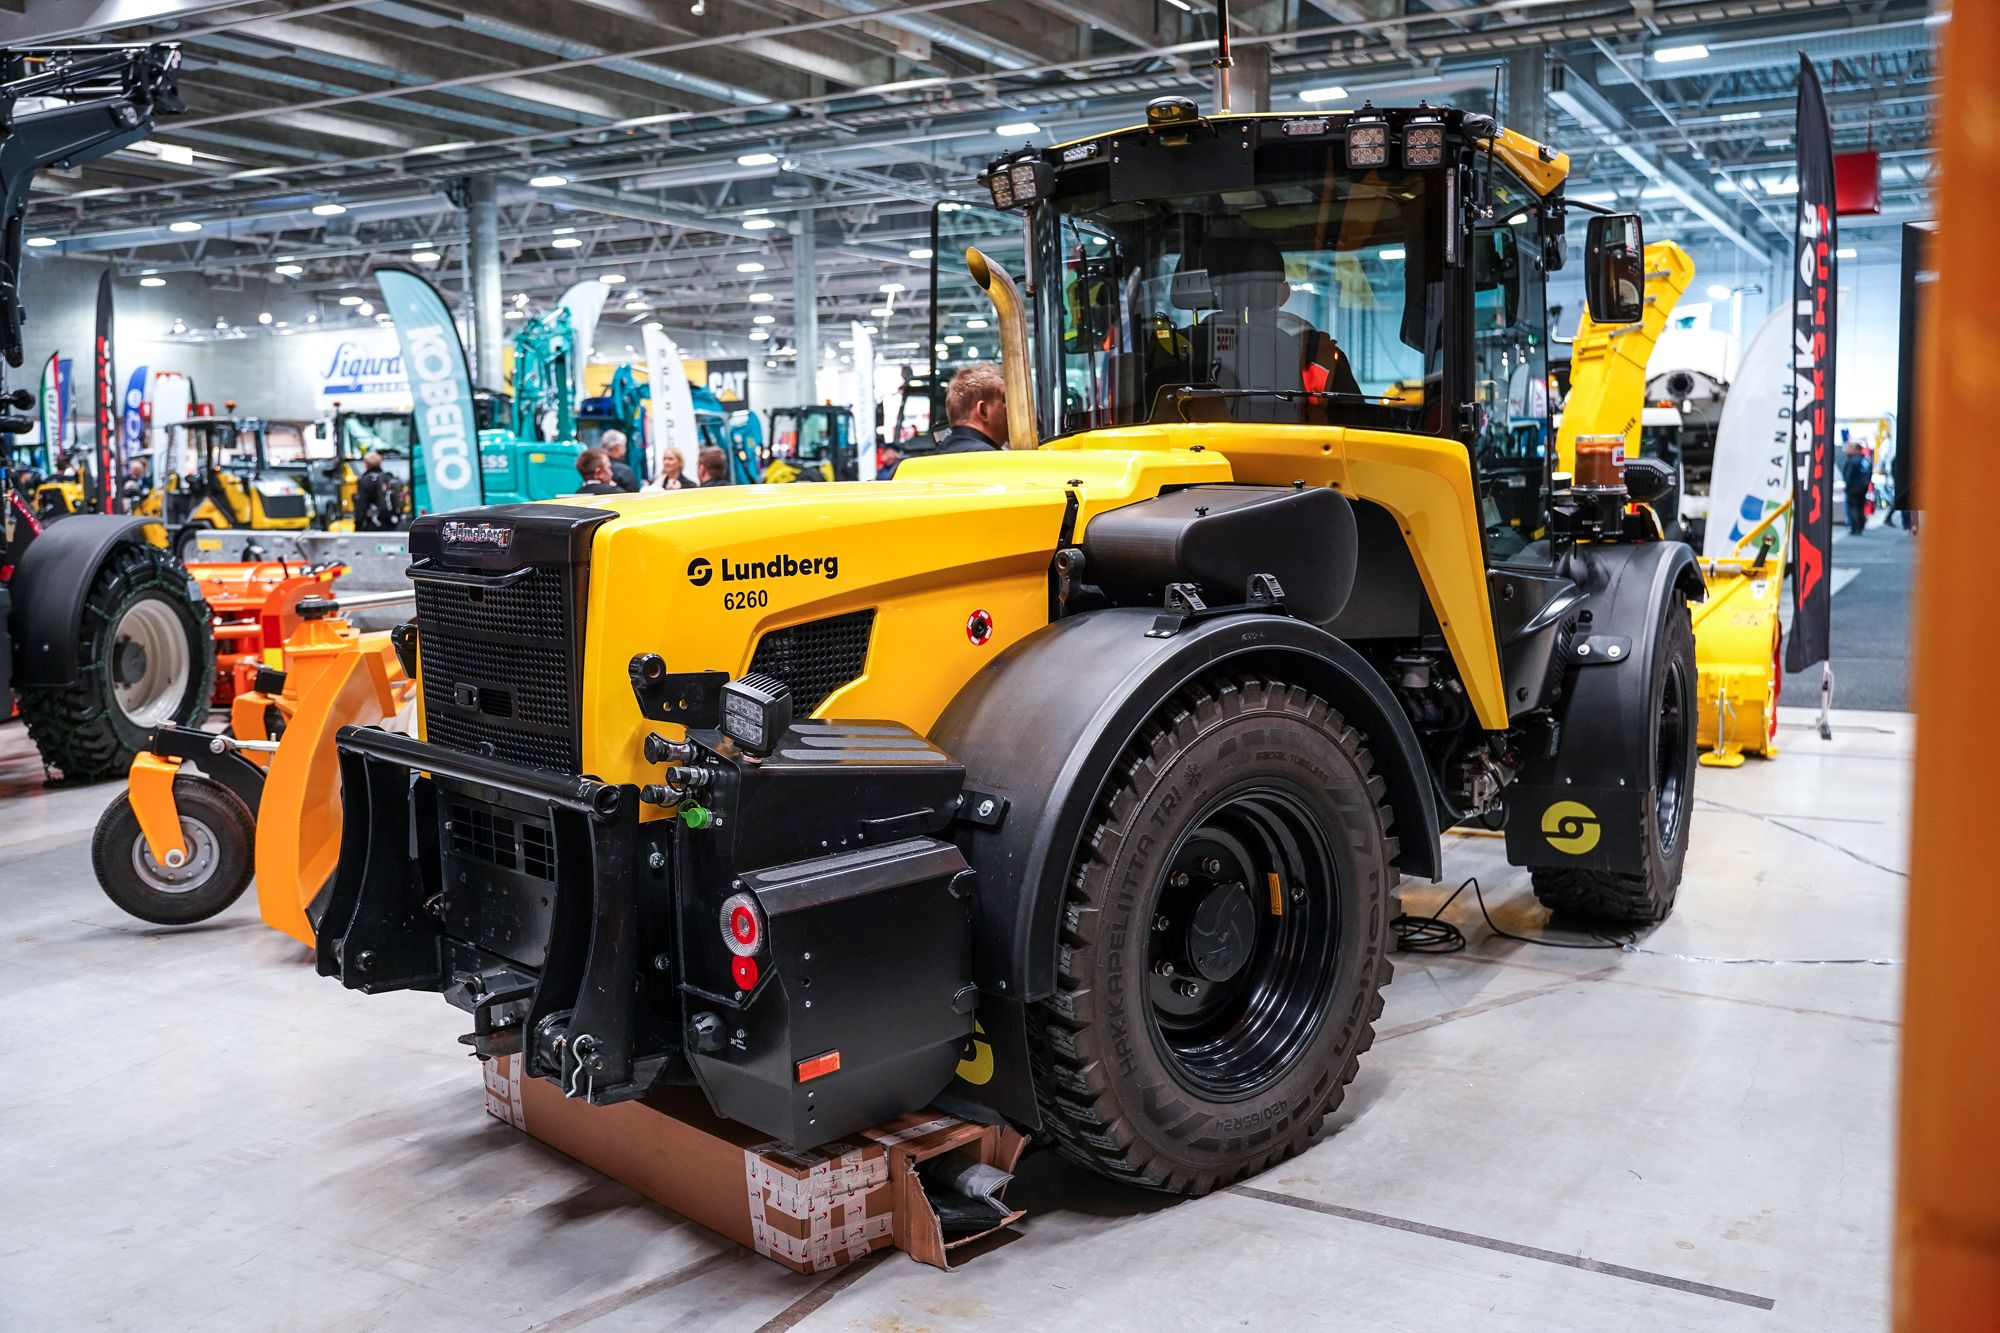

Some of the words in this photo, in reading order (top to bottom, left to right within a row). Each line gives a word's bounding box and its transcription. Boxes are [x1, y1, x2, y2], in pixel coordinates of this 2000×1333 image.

[708, 371, 748, 401] CAT
[722, 554, 838, 580] Lundberg
[724, 589, 768, 610] 6260
[1215, 1100, 1288, 1132] 420/65R24
